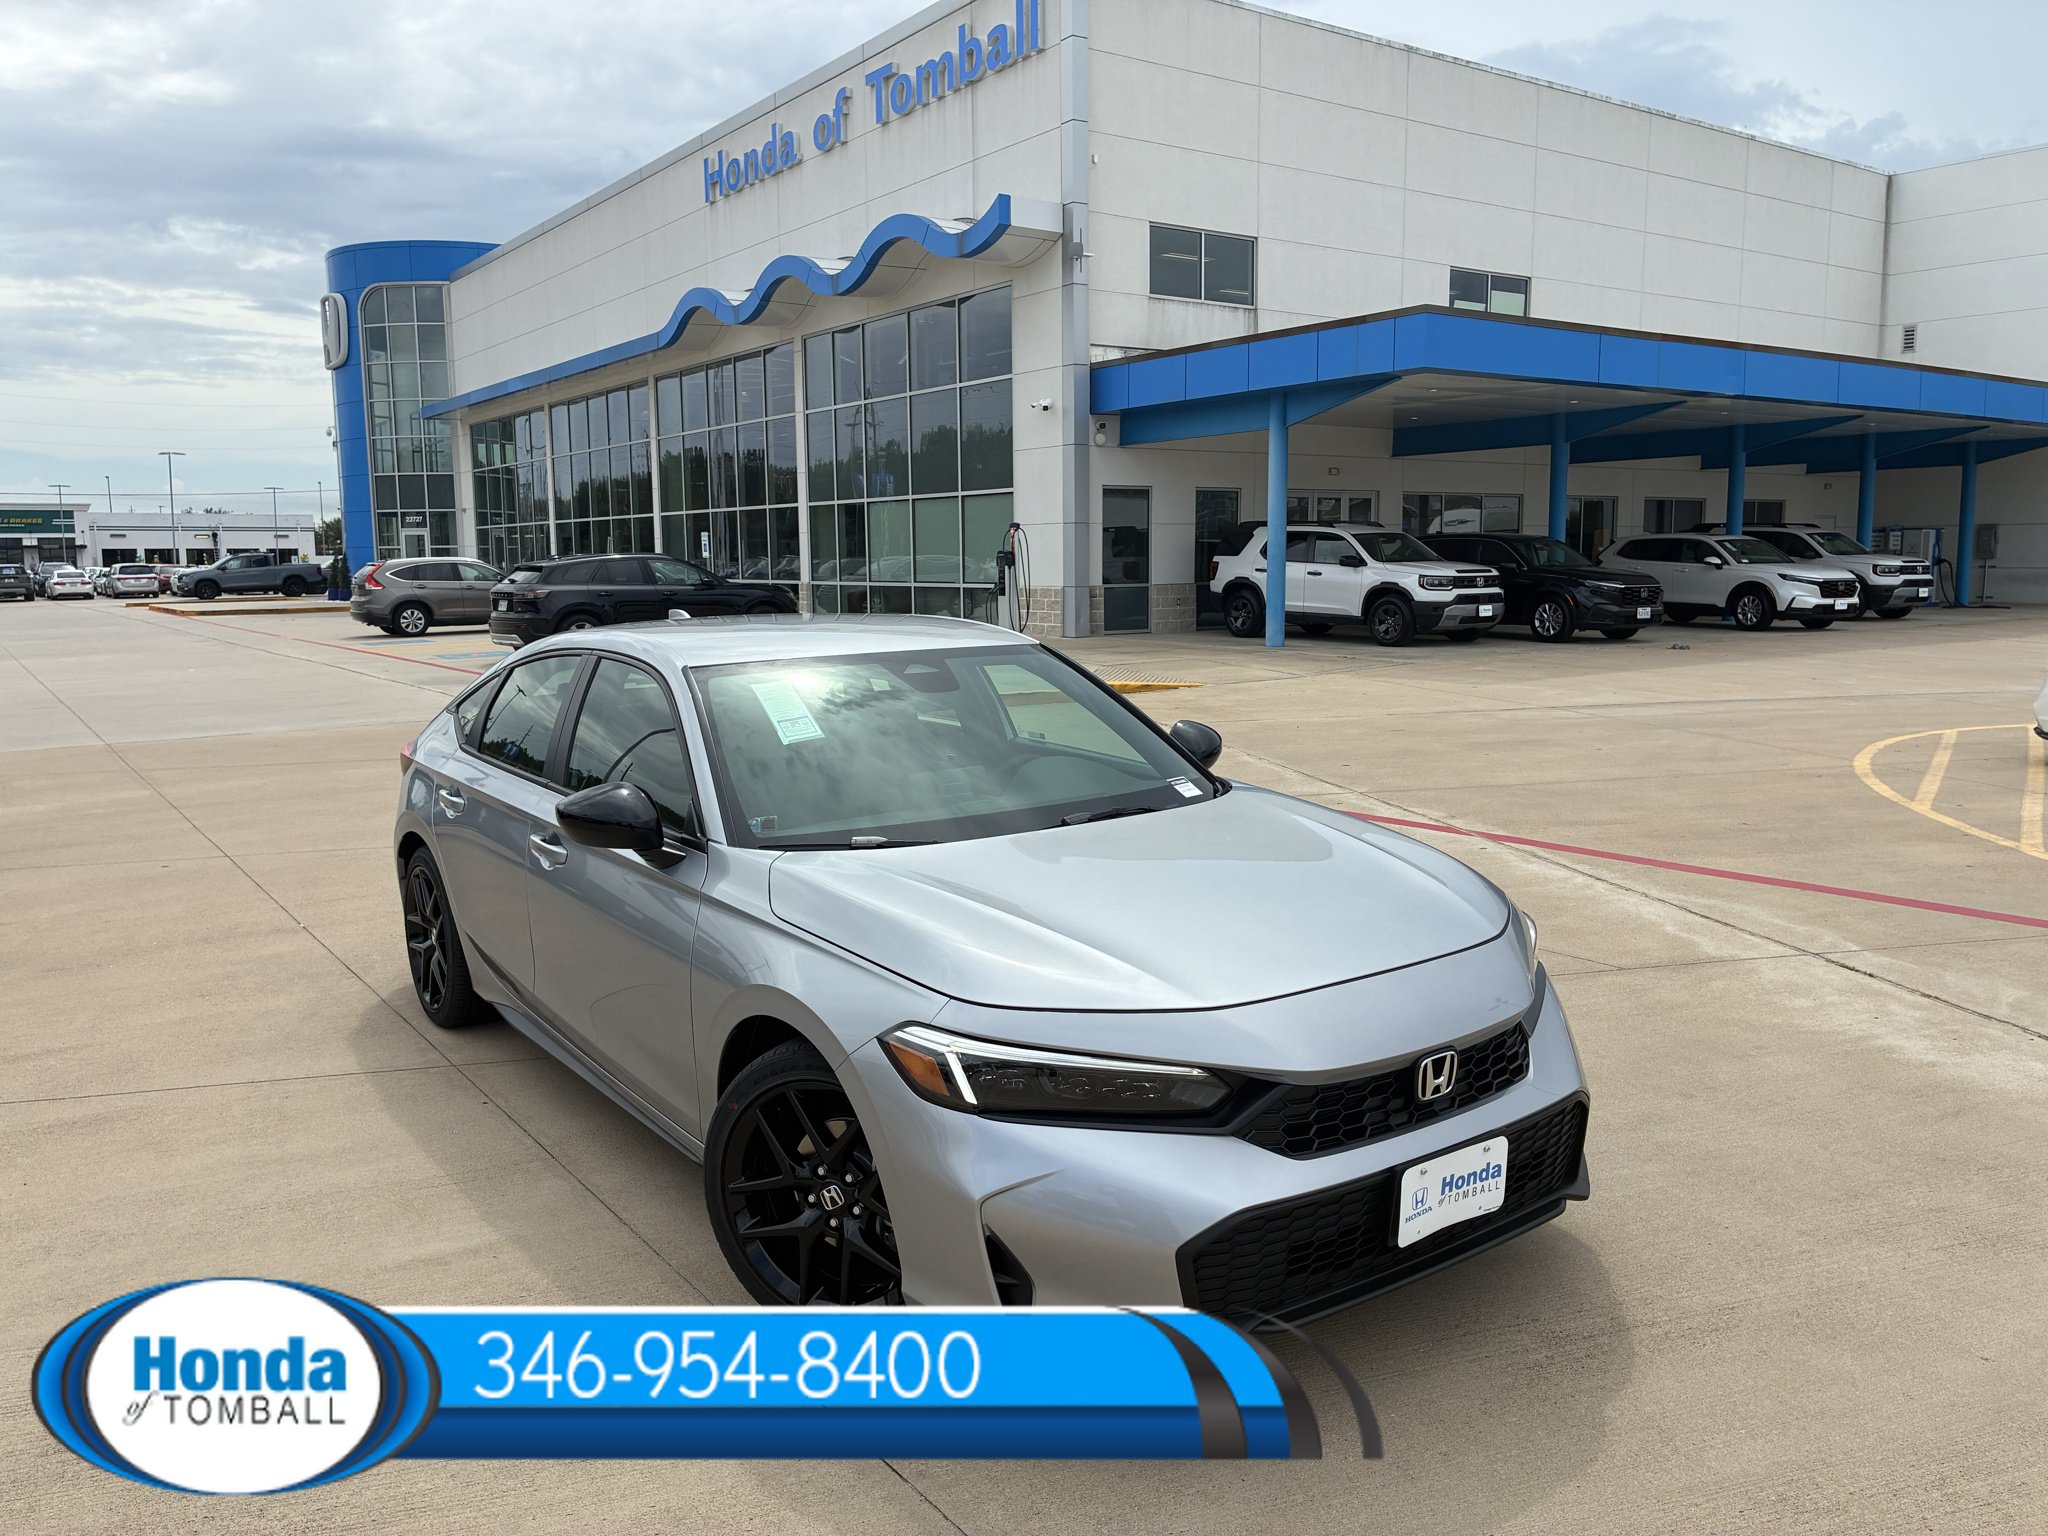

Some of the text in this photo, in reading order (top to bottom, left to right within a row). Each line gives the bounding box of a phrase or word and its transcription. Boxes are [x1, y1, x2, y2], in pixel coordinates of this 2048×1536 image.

[703, 0, 1046, 204] Honda of Tomball
[1437, 1180, 1501, 1208] of TOMBALL
[1440, 1162, 1502, 1197] Honda
[1404, 1206, 1433, 1224] HONDA
